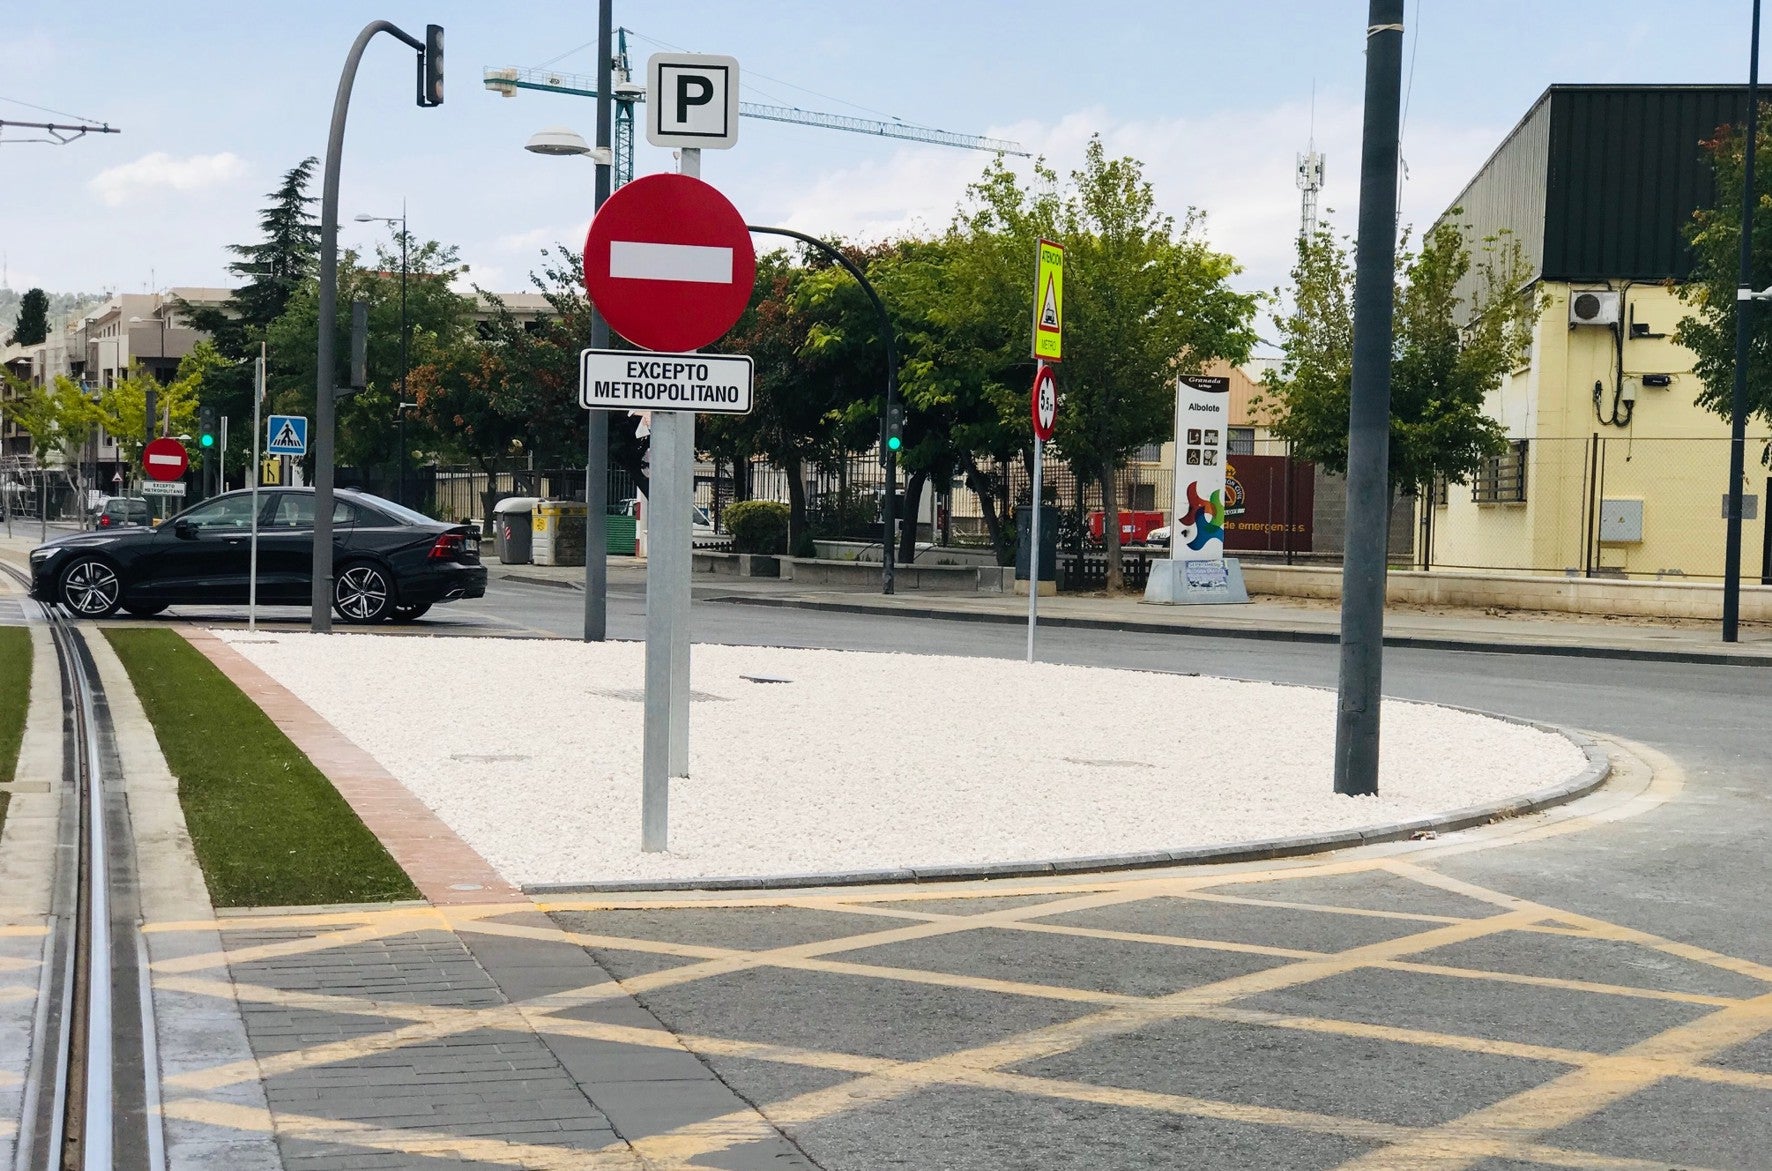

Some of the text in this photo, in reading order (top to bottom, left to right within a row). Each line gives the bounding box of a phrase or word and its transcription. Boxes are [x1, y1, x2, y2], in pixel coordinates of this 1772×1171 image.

[677, 75, 713, 123] P
[1041, 338, 1056, 351] METRO
[627, 361, 708, 381] EXCEPTO
[1188, 376, 1221, 384] Granada
[594, 381, 739, 402] METROPOLITANO
[1188, 402, 1220, 412] Albolote
